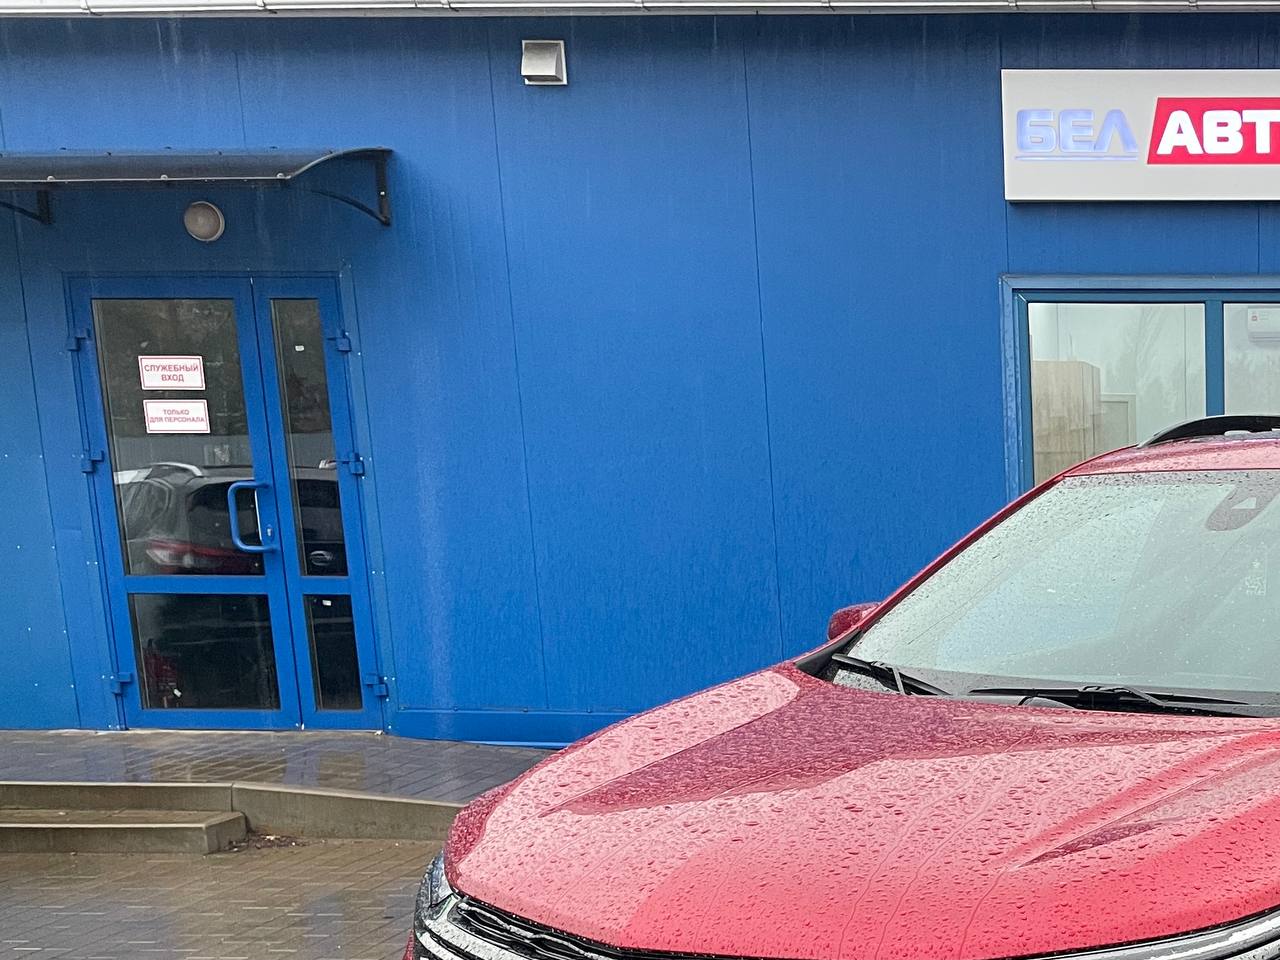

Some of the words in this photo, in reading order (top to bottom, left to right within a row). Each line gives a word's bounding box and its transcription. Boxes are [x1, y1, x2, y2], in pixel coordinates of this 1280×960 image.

[1015, 108, 1139, 153] БЕЛ
[144, 364, 199, 372] СЛУЖЕБНЫЙ
[161, 374, 184, 382] ВХОД
